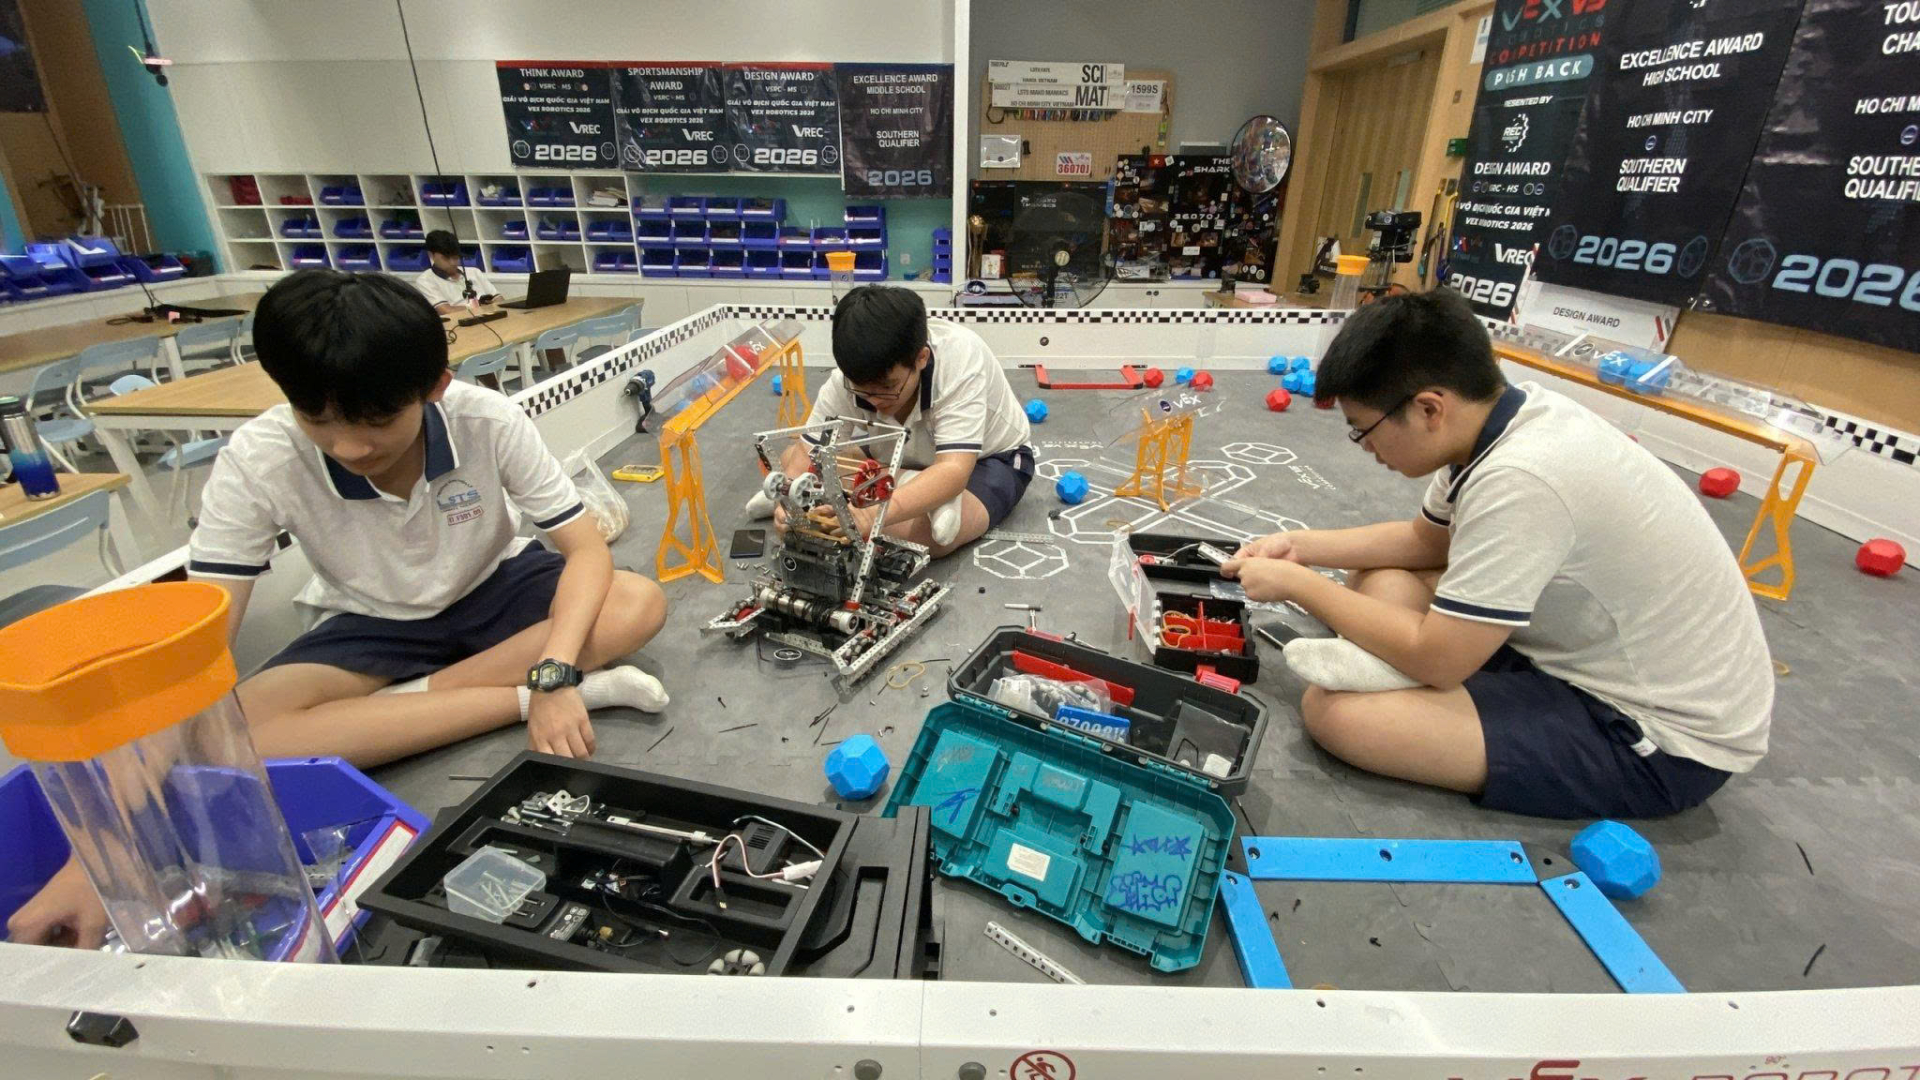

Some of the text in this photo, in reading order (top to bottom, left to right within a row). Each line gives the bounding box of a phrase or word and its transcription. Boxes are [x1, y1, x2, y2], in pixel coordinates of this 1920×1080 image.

[1490, 31, 1602, 64] COPETITION
[1620, 32, 1763, 70] EXCELLENCE AWARD
[520, 69, 584, 78] THINK AWARD
[627, 67, 704, 76] SPORTSMANSHIP
[744, 71, 814, 81] DESIGN AWARD
[1081, 64, 1104, 83] SCI
[1535, 60, 1582, 80] BACK
[1642, 63, 1721, 86] HIGH SCHOOL
[649, 81, 683, 90] AWARD
[853, 74, 938, 84] EXCELLENCE AWARD
[866, 85, 926, 94] MIDDLE SCHOOL
[1075, 85, 1107, 106] MAT
[1131, 84, 1159, 94] 1599S
[1539, 95, 1553, 104] BY
[1854, 98, 1880, 114] HO
[1880, 96, 1906, 113] CHI
[1626, 115, 1642, 128] HO
[1652, 110, 1682, 126] MINH
[1682, 109, 1714, 125] CITY
[569, 121, 601, 134] VREC
[682, 128, 714, 141] VREC
[791, 124, 824, 138] VREC
[876, 130, 919, 139] SOUTHERN
[1503, 126, 1523, 137] REC
[878, 139, 920, 148] QUALIFIER
[535, 144, 597, 161] 2026
[645, 149, 708, 165] 2026
[754, 147, 818, 165] 2026
[1212, 157, 1231, 165] THE
[1503, 161, 1551, 176] AWARD
[1619, 158, 1687, 174] SOUTHERN
[868, 169, 932, 187] 2026
[1616, 176, 1681, 193] QUALIFIER
[1506, 184, 1519, 193] HS
[1504, 206, 1521, 216] GIA
[1523, 205, 1545, 218] VIỆT
[1465, 217, 1479, 226] VEX
[1510, 221, 1534, 231] 2026
[1573, 235, 1677, 275] 2026
[1450, 273, 1516, 308] 2026
[1552, 306, 1620, 328] DESIGN AWARD
[1593, 350, 1630, 367] VEX
[1172, 392, 1202, 409] VEX
